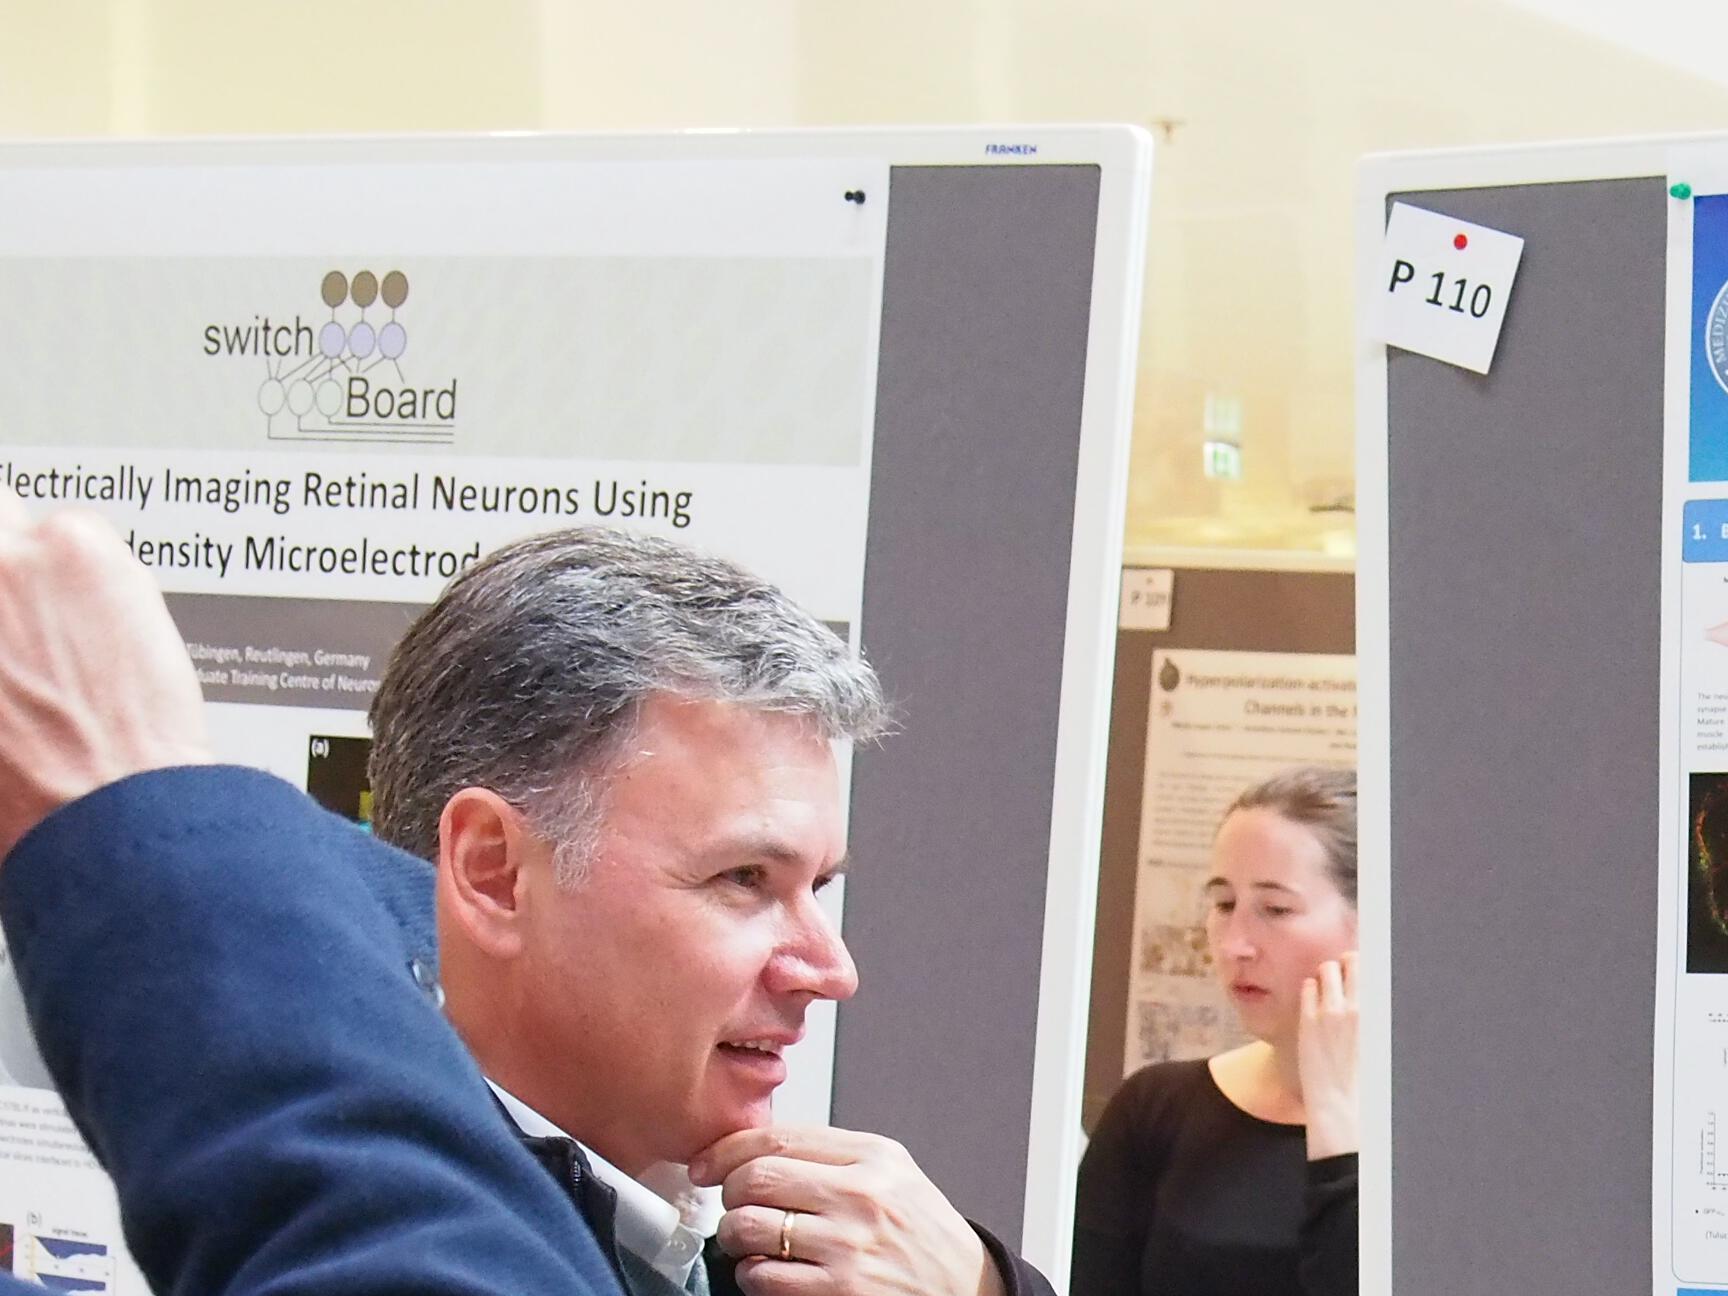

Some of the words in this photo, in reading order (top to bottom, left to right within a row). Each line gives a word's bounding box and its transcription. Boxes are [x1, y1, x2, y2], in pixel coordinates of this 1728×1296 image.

[1389, 259, 1415, 293] P
[1425, 271, 1492, 318] 110
[203, 316, 314, 357] switch
[346, 377, 457, 419] Board
[0, 462, 153, 511] lectrically
[166, 469, 291, 514] Imaging
[304, 473, 418, 509] Retinal
[433, 476, 578, 515] Neurons
[595, 481, 692, 528] Using
[1693, 524, 1706, 539] 1.
[246, 536, 480, 578] Microelectrod
[311, 739, 329, 758] (a)
